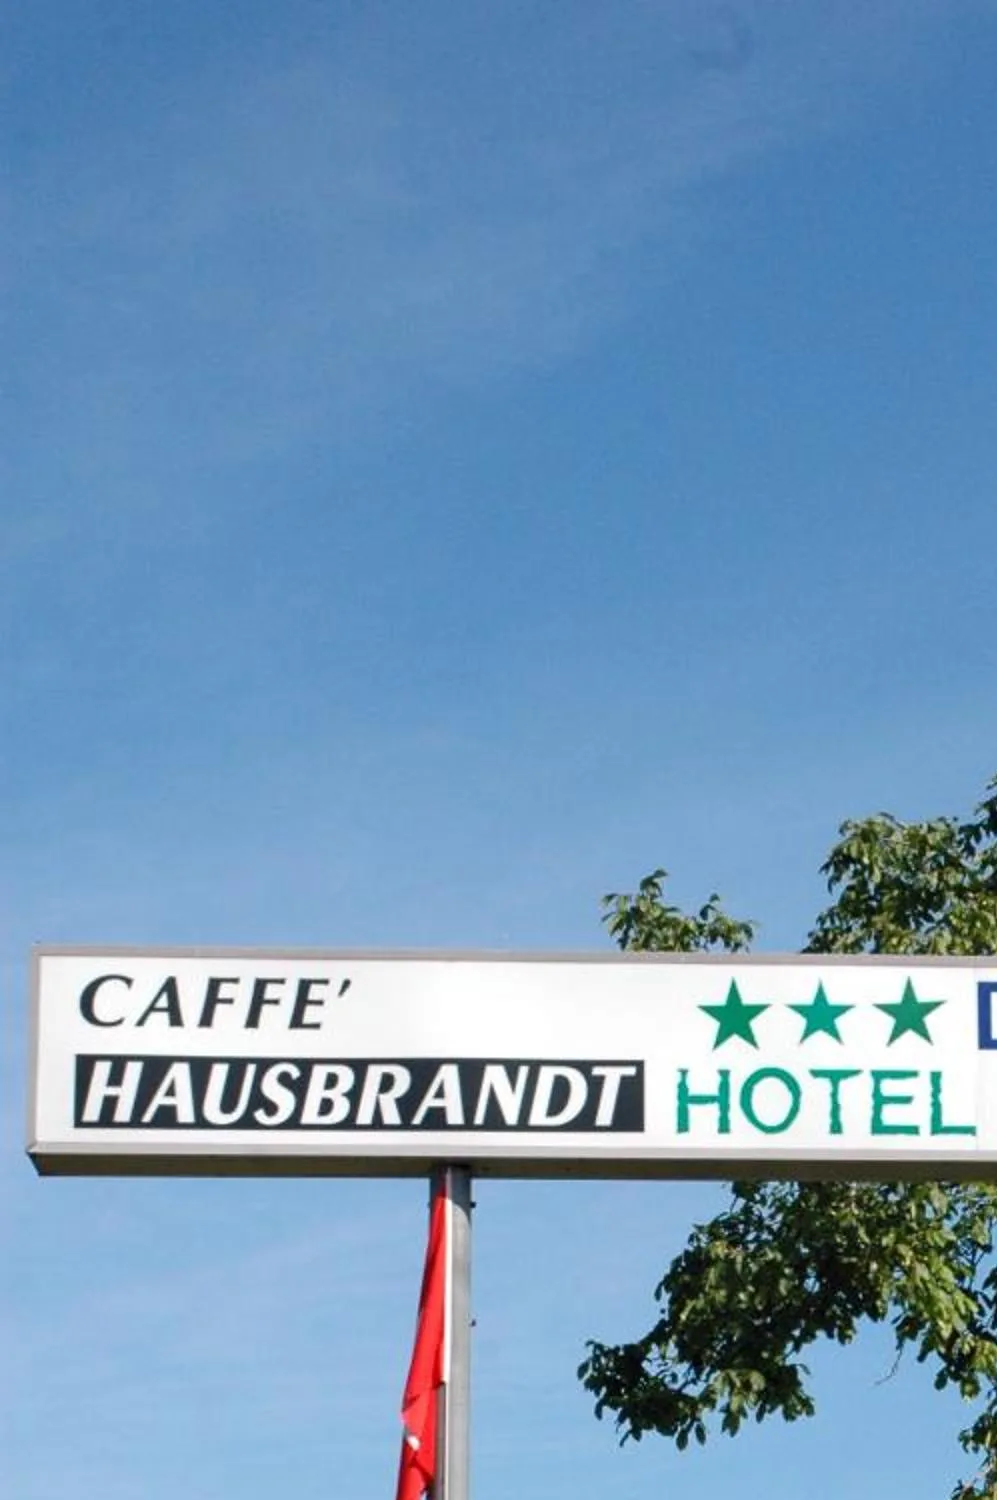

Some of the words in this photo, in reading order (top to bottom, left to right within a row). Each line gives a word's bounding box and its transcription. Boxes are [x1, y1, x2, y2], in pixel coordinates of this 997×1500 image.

[79, 974, 351, 1030] CAFFE'
[80, 1059, 637, 1128] HAUSBRANDT
[676, 1066, 977, 1136] HOTEL
